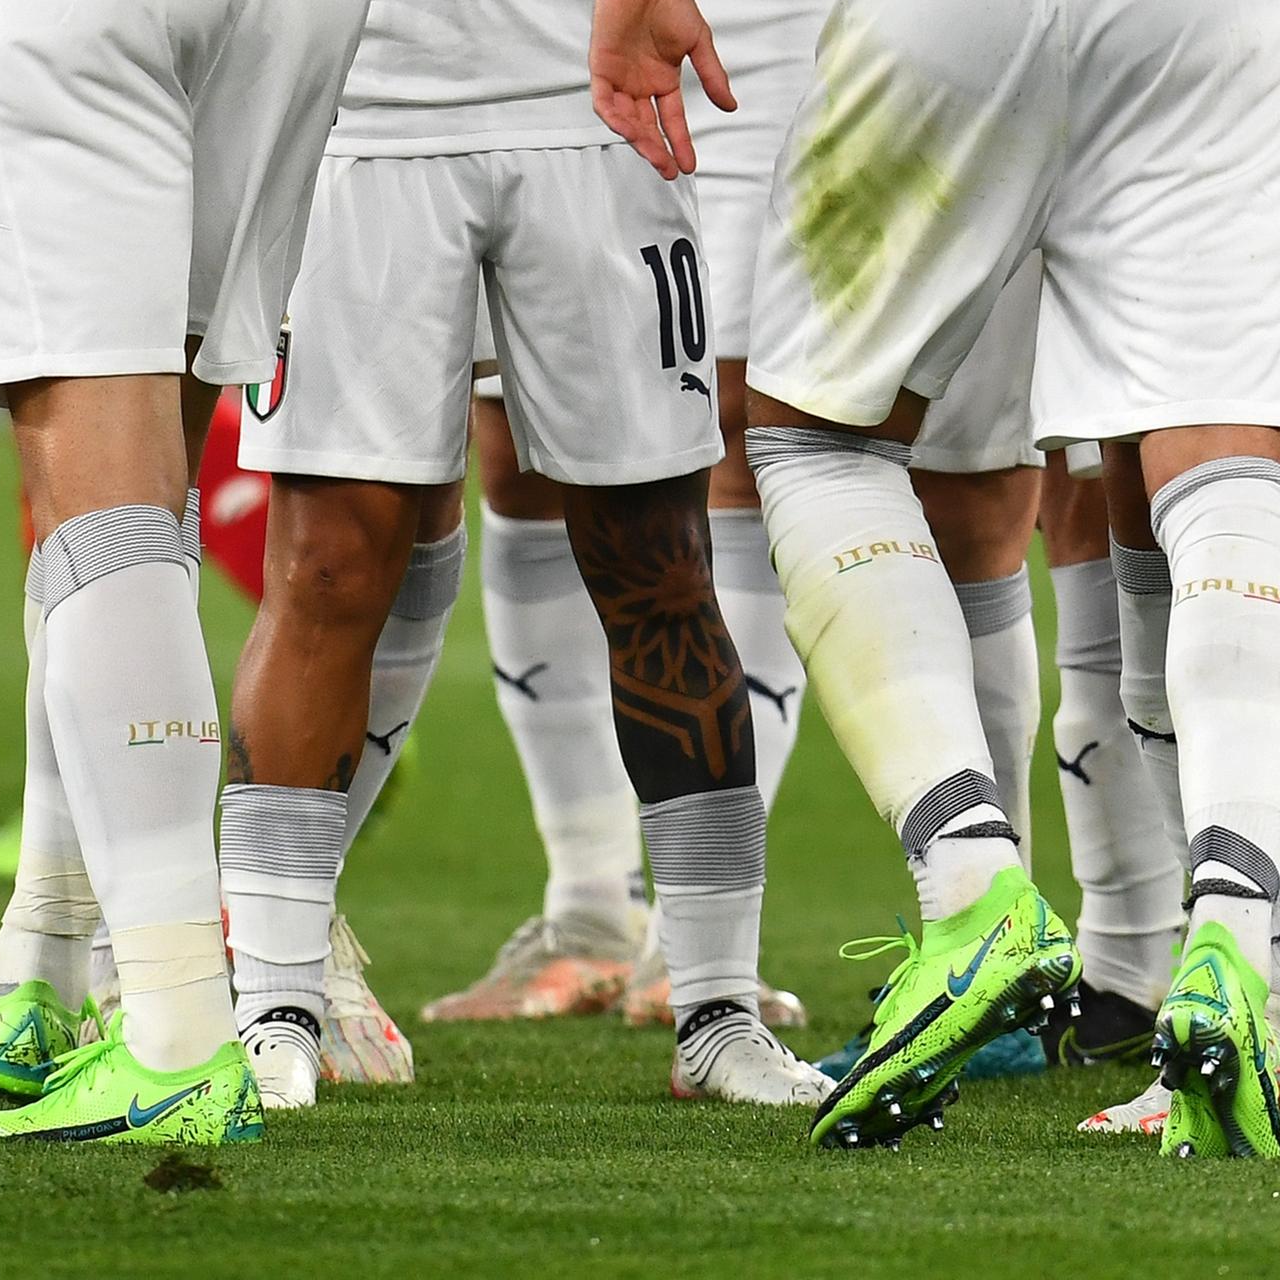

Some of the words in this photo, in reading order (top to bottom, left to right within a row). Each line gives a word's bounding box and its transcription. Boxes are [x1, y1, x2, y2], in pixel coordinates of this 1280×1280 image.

[639, 237, 706, 370] 10
[833, 541, 934, 569] ITALIA
[1176, 578, 1280, 602] ITALIA
[129, 720, 219, 740] ITALIA
